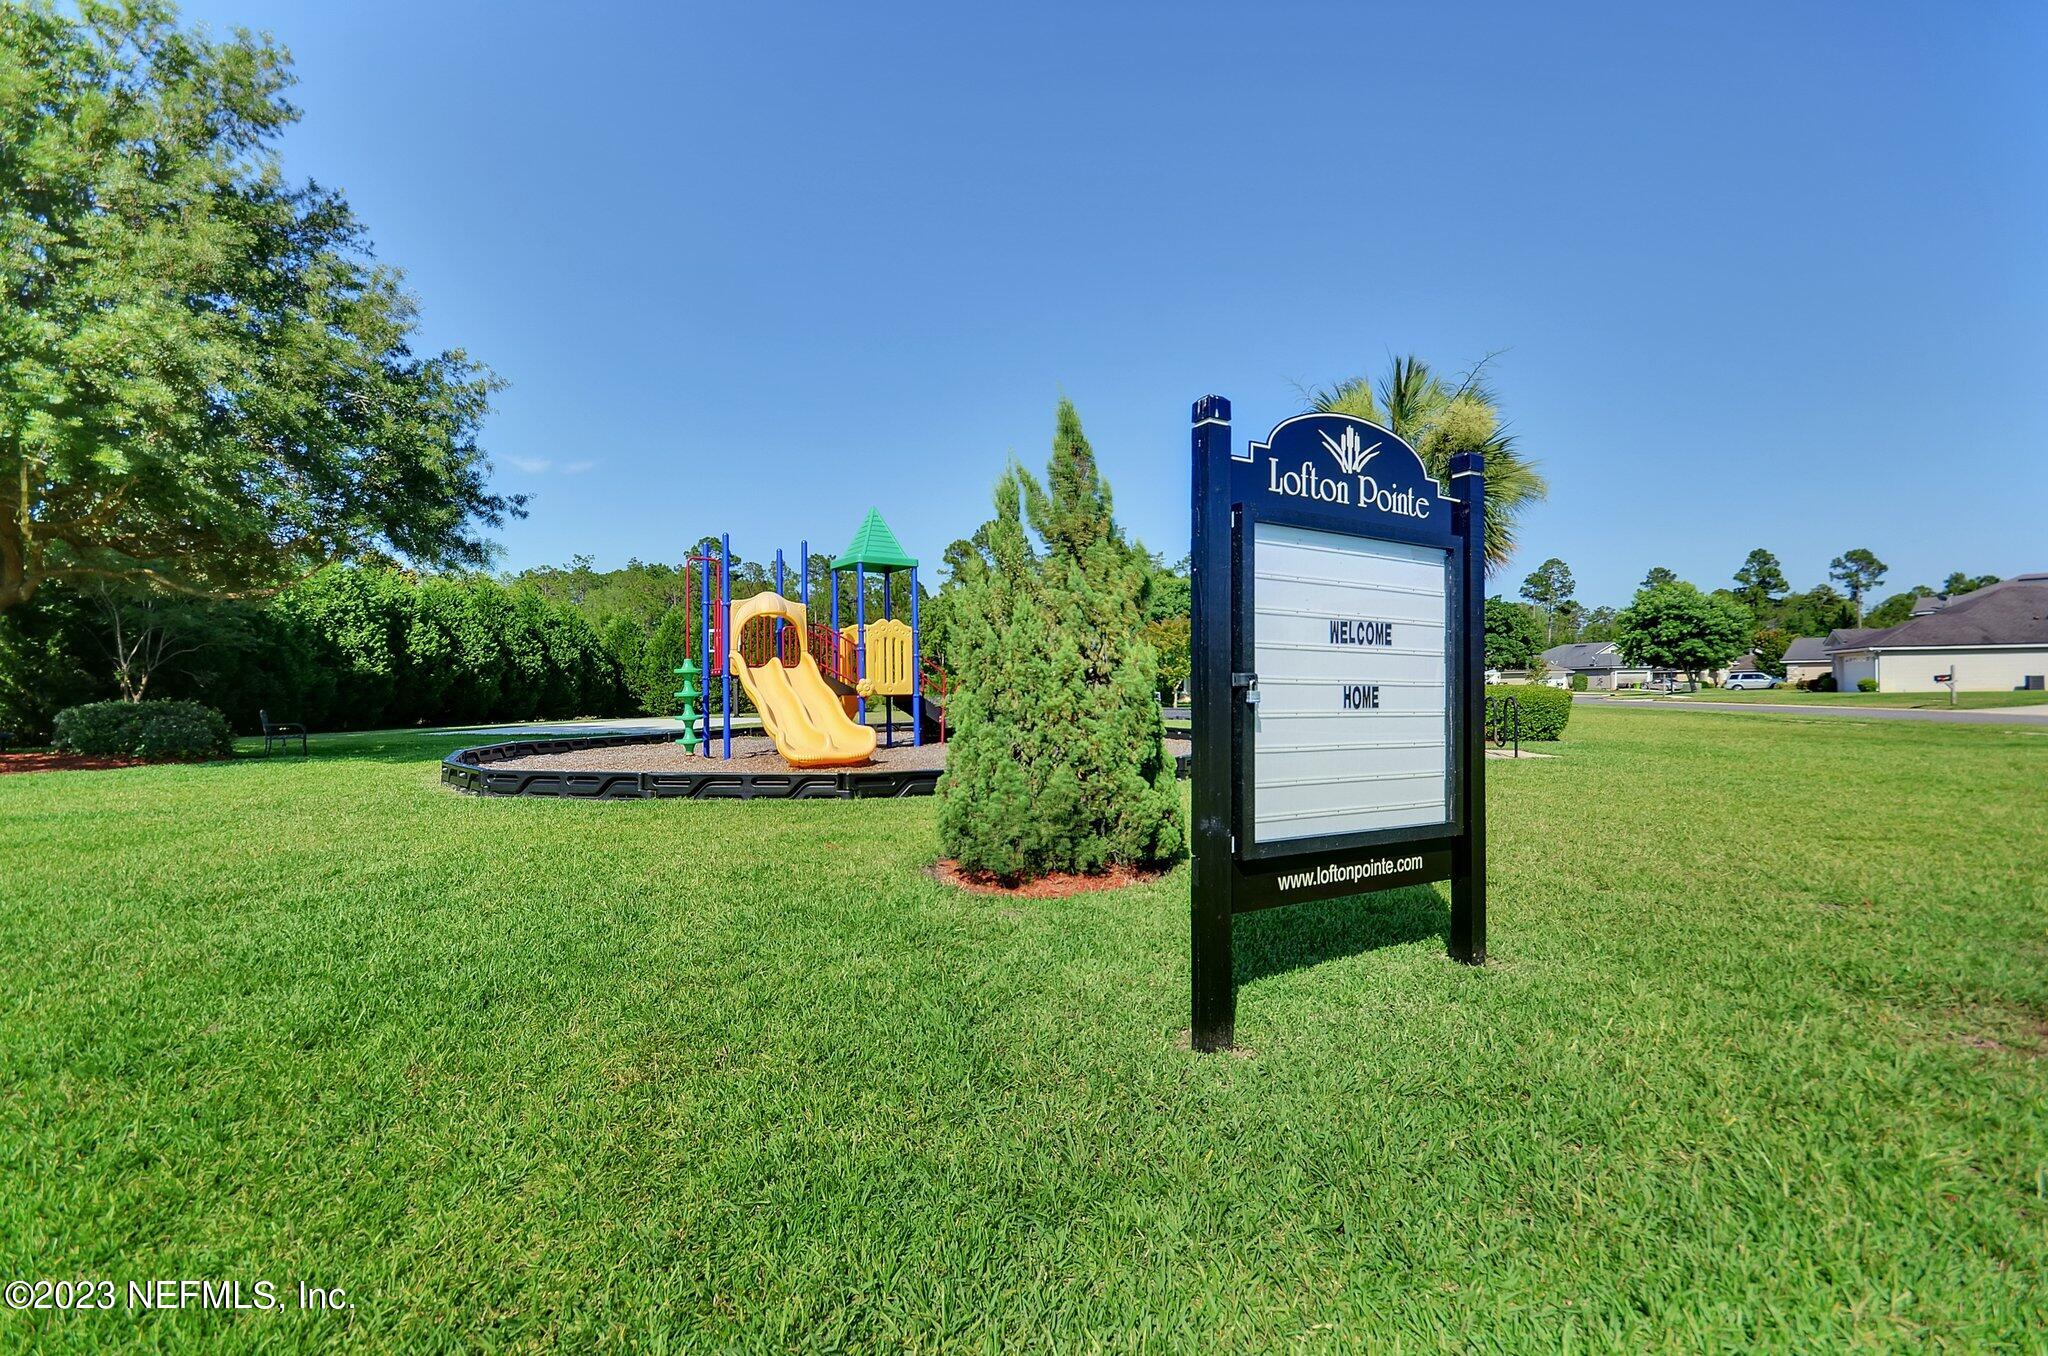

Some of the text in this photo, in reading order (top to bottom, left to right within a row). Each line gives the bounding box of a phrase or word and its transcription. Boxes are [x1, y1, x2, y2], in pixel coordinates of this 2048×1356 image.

[1268, 457, 1430, 519] Lofton Pointe
[1330, 620, 1392, 646] WELCOME
[1343, 685, 1379, 709] HOME
[1278, 855, 1423, 891] www.loftonpointe.com
